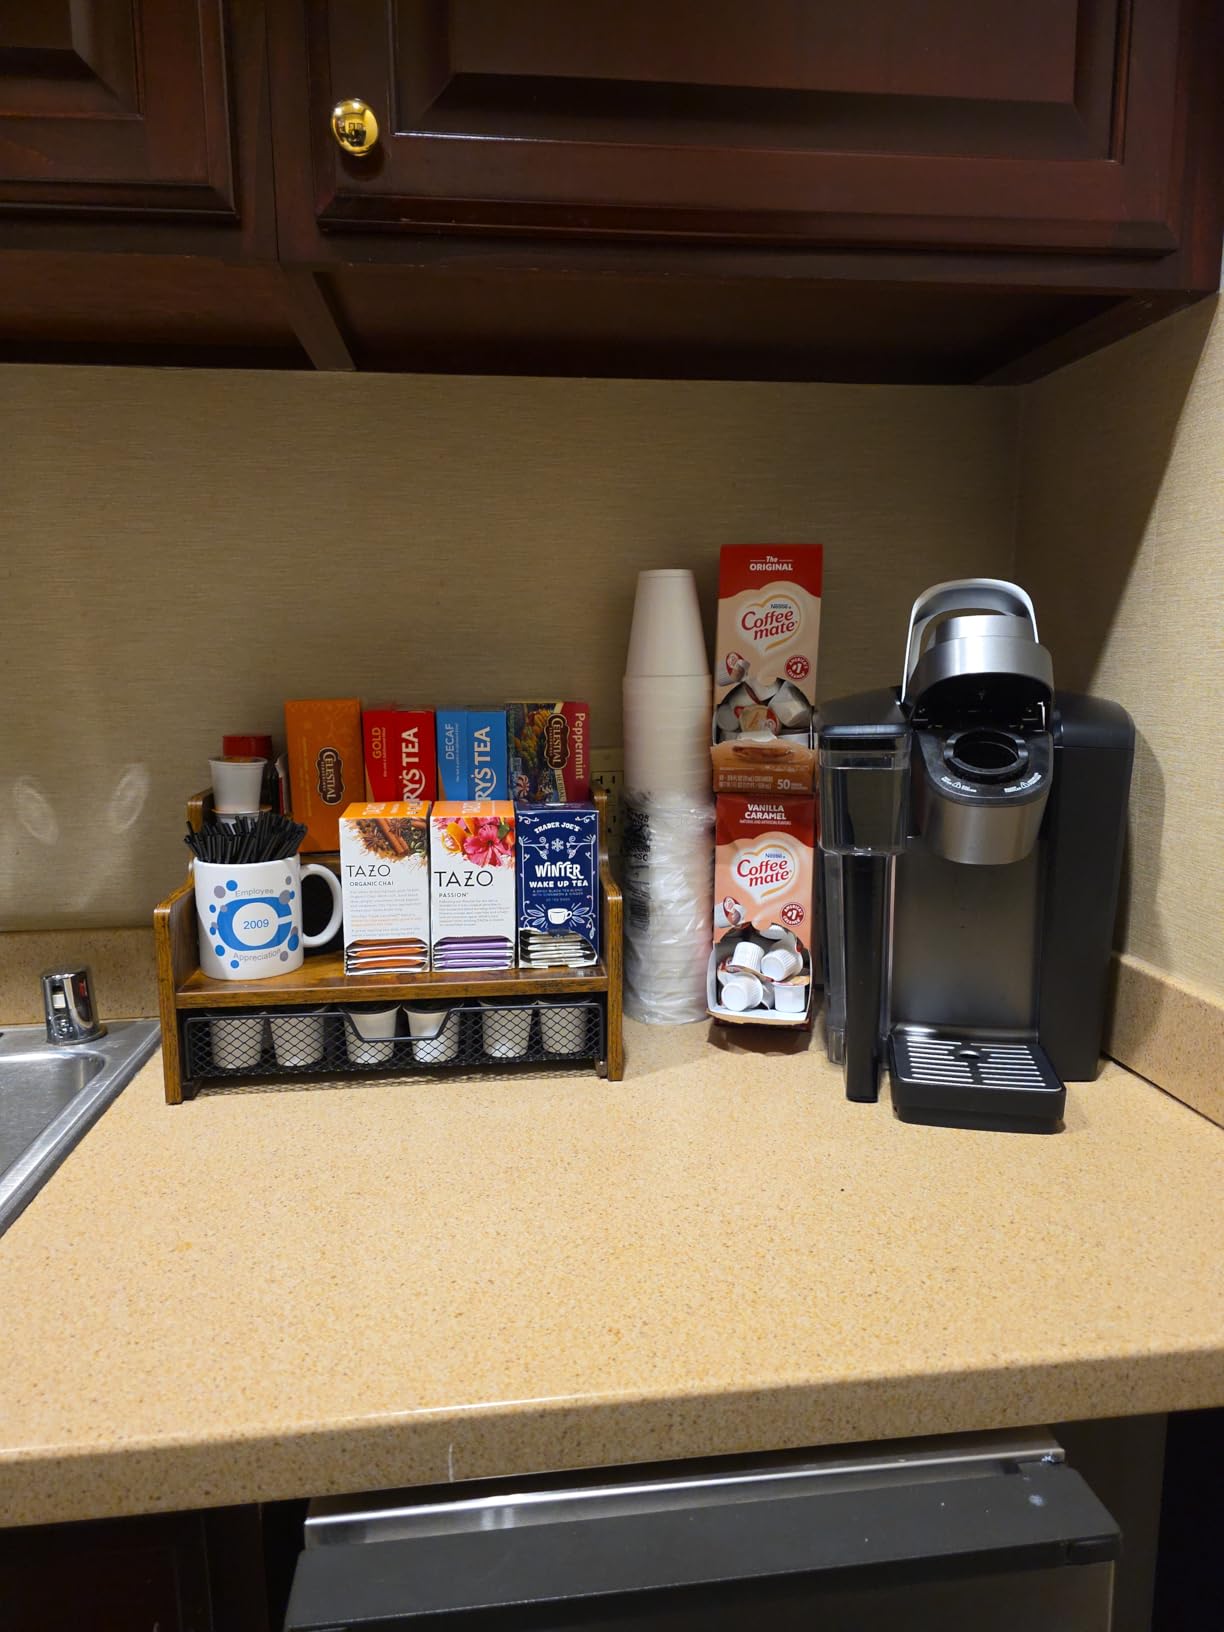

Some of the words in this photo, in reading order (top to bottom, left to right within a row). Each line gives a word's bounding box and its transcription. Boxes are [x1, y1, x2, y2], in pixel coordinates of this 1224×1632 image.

[749, 563, 793, 571] ORIGINAL
[741, 610, 794, 631] Coffee
[754, 621, 795, 640] mate
[372, 727, 381, 759] GOLD
[401, 727, 418, 767] TEA
[445, 723, 454, 760] DECAF
[474, 726, 491, 765] TEA
[551, 717, 563, 764] CELESTIAL
[572, 712, 585, 779] Peppermint
[322, 751, 337, 801] CELESTIAL
[777, 779, 791, 790] 50
[744, 811, 787, 820] CARAMEL
[747, 804, 785, 812] VANILLA
[534, 822, 560, 833] TRADER
[561, 822, 581, 832] JOE'S
[346, 864, 391, 878] TAZO
[535, 861, 584, 879] WINTER
[736, 859, 788, 878] Coffee
[434, 870, 493, 887] TAZO
[749, 870, 789, 887] mate
[235, 888, 274, 897] Employee
[243, 919, 269, 930] 2009
[234, 949, 280, 962] Appreciation
